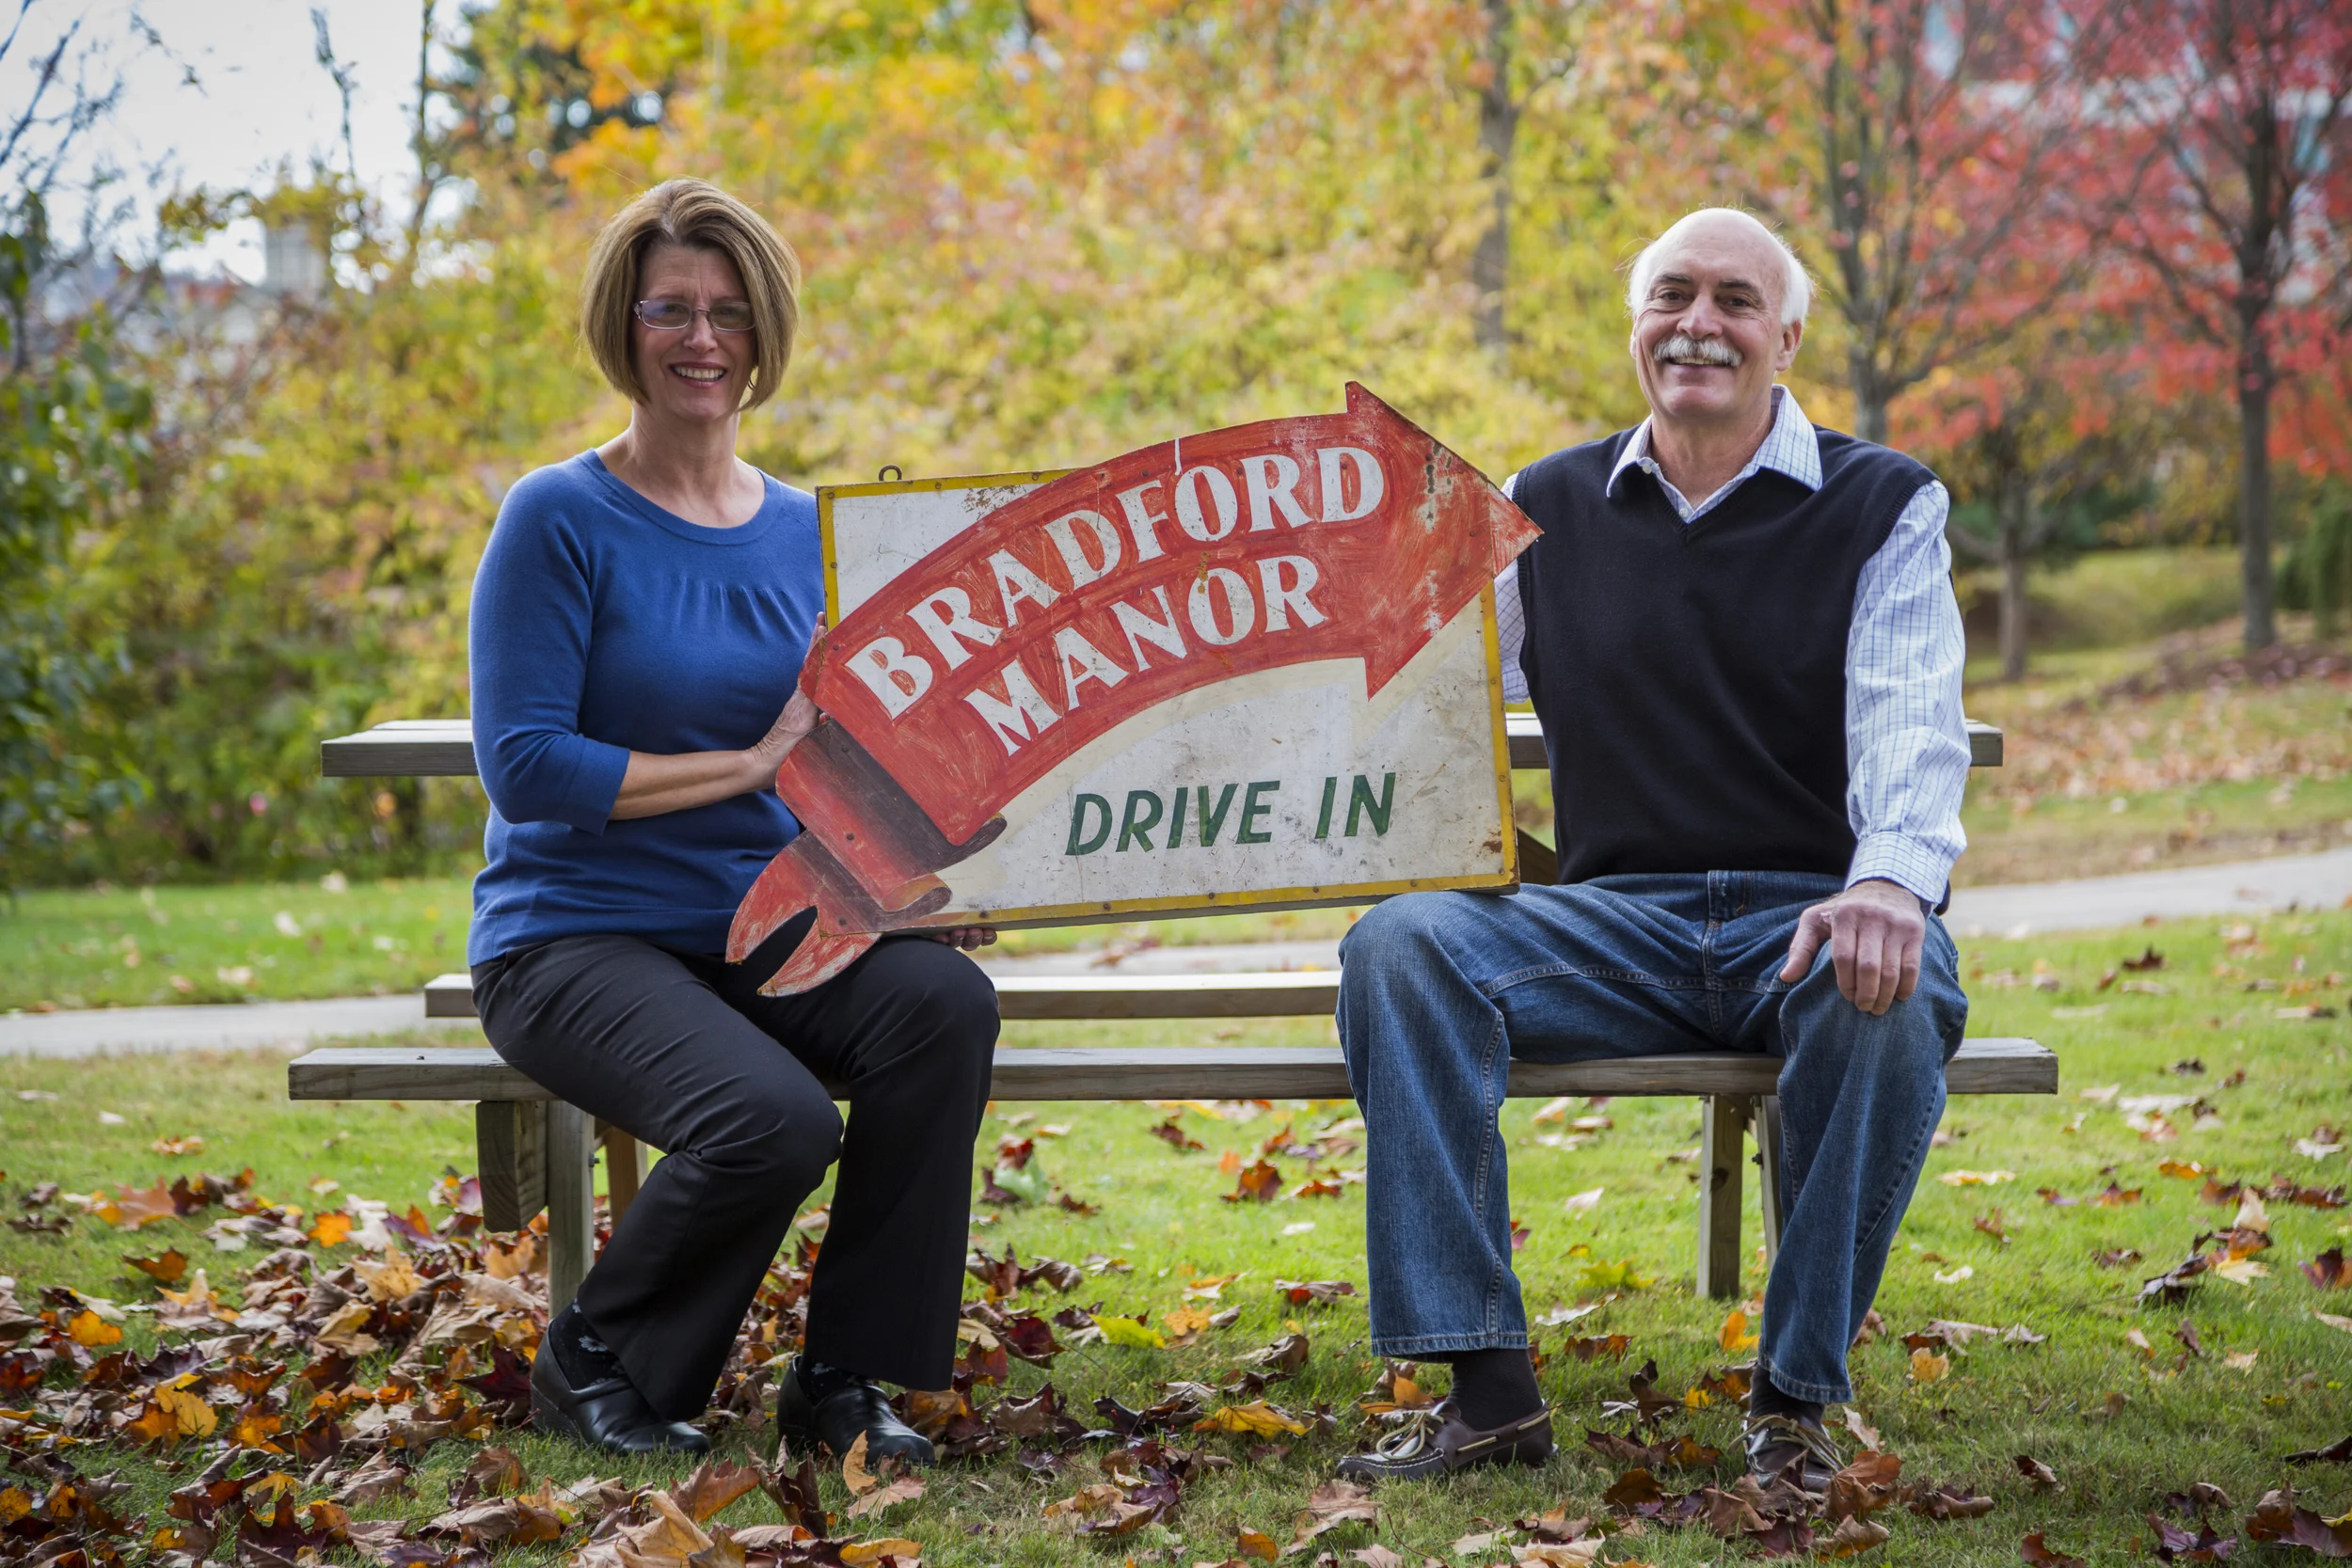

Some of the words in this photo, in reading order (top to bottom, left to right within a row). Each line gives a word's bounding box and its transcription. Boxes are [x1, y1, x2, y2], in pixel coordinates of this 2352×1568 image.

[845, 446, 1385, 721] BRADFORD
[964, 555, 1328, 755] MANOR
[1064, 781, 1280, 856] DRIVE
[1314, 772, 1396, 839] IN
